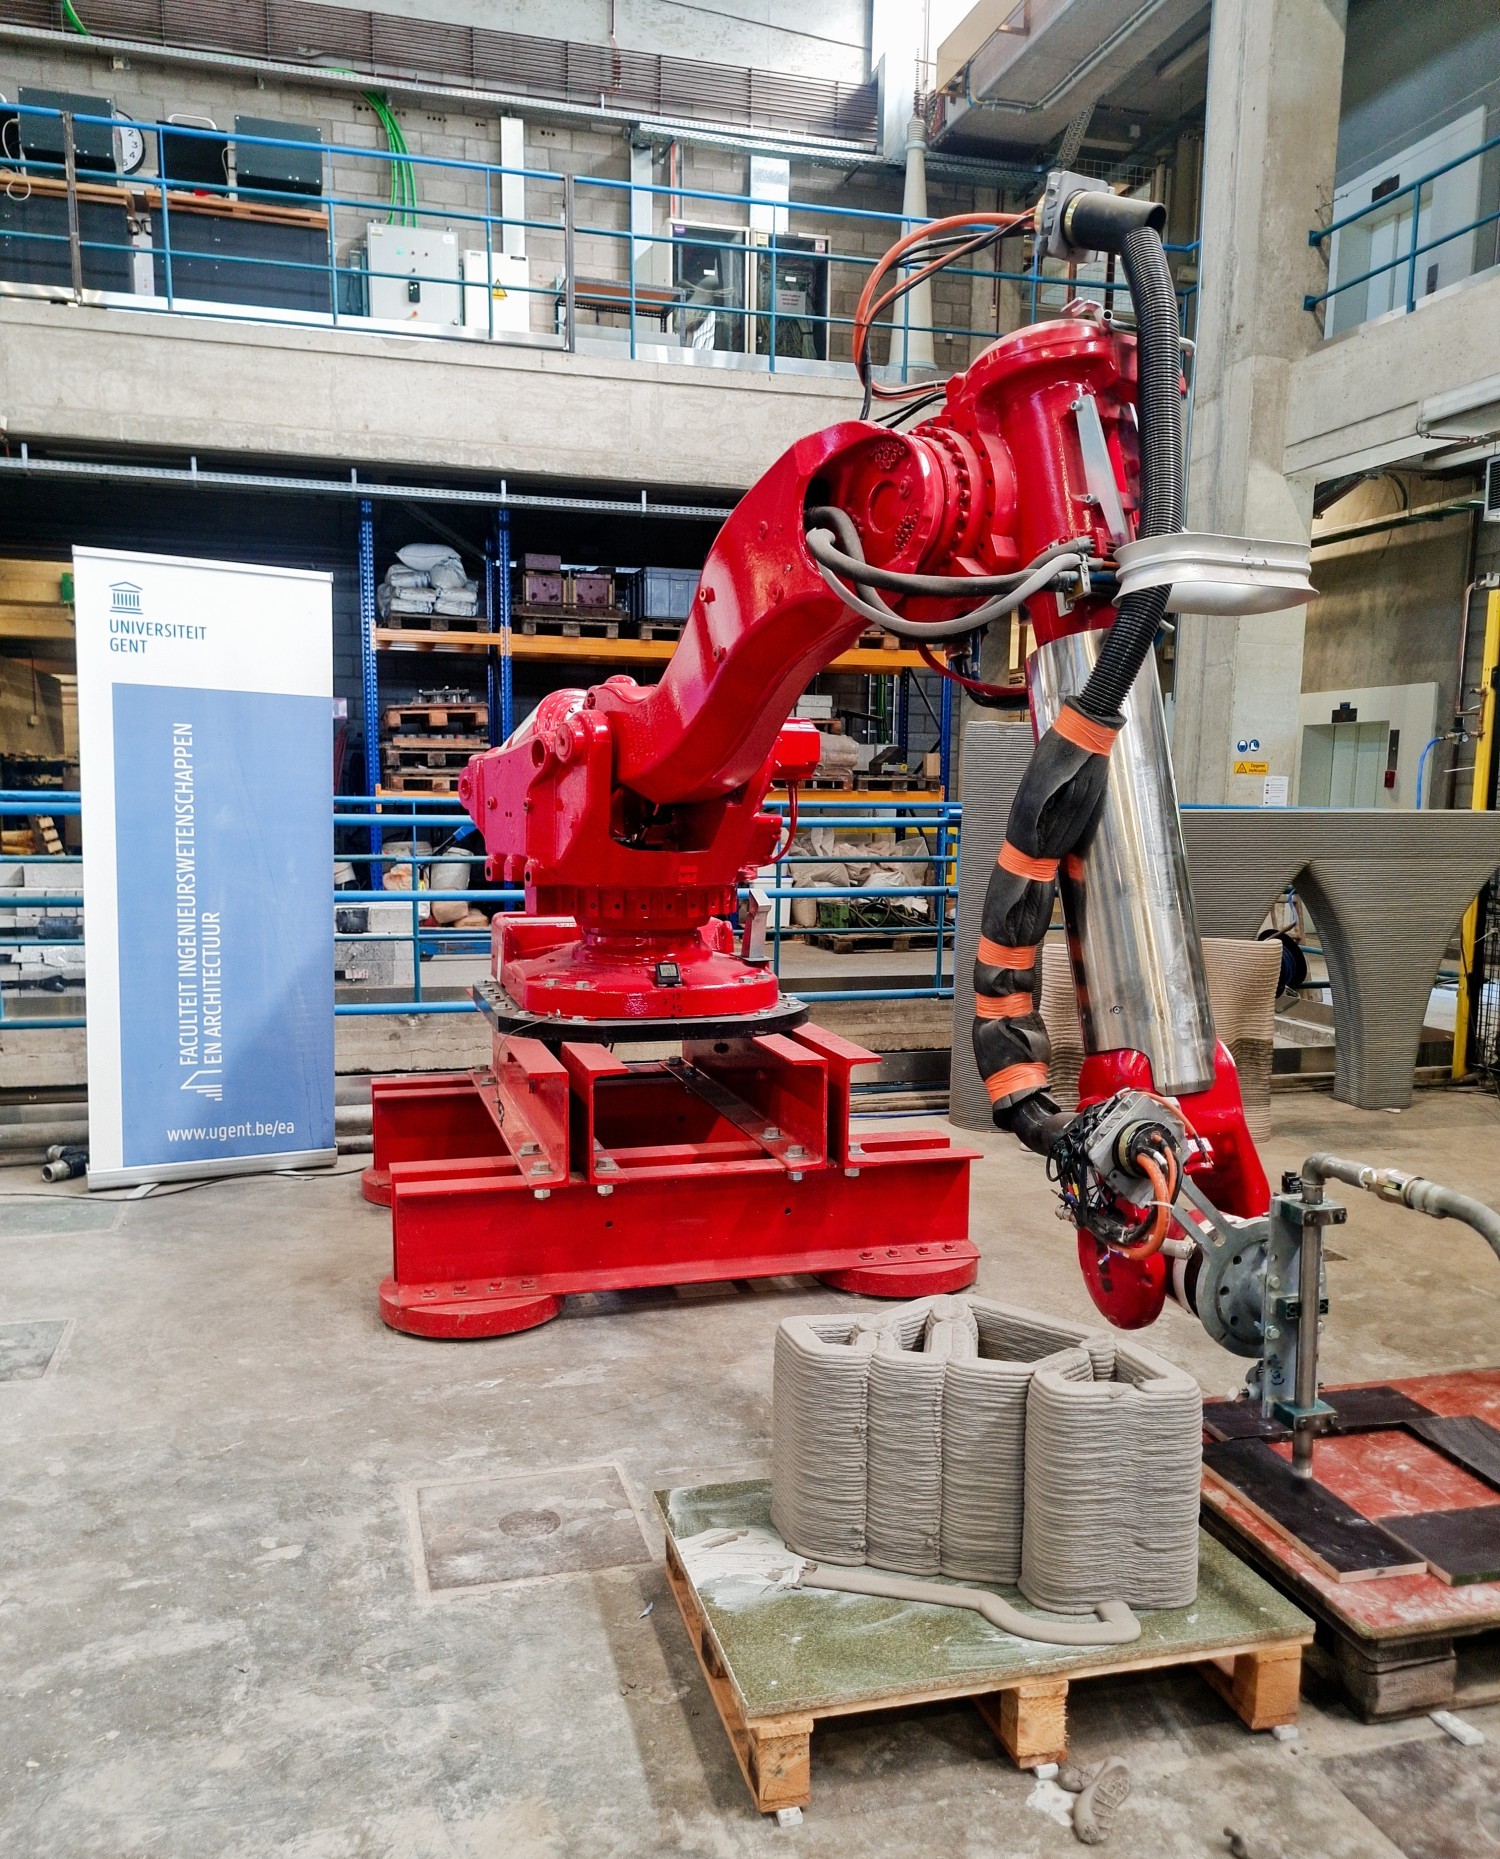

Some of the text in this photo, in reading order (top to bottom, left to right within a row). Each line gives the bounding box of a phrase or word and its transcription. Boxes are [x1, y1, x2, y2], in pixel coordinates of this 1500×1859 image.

[128, 129, 134, 137] 2
[131, 141, 138, 149] 3
[129, 151, 135, 159] 4
[109, 619, 207, 640] UNIVERSITEIT
[109, 639, 148, 654] GENT
[173, 723, 198, 1066] FACULTEIT INGENIEURSWETENSCHAPPEN
[201, 912, 222, 1064] EN ARCHITECTUUR
[167, 1120, 295, 1143] www.ugent.be/ea
